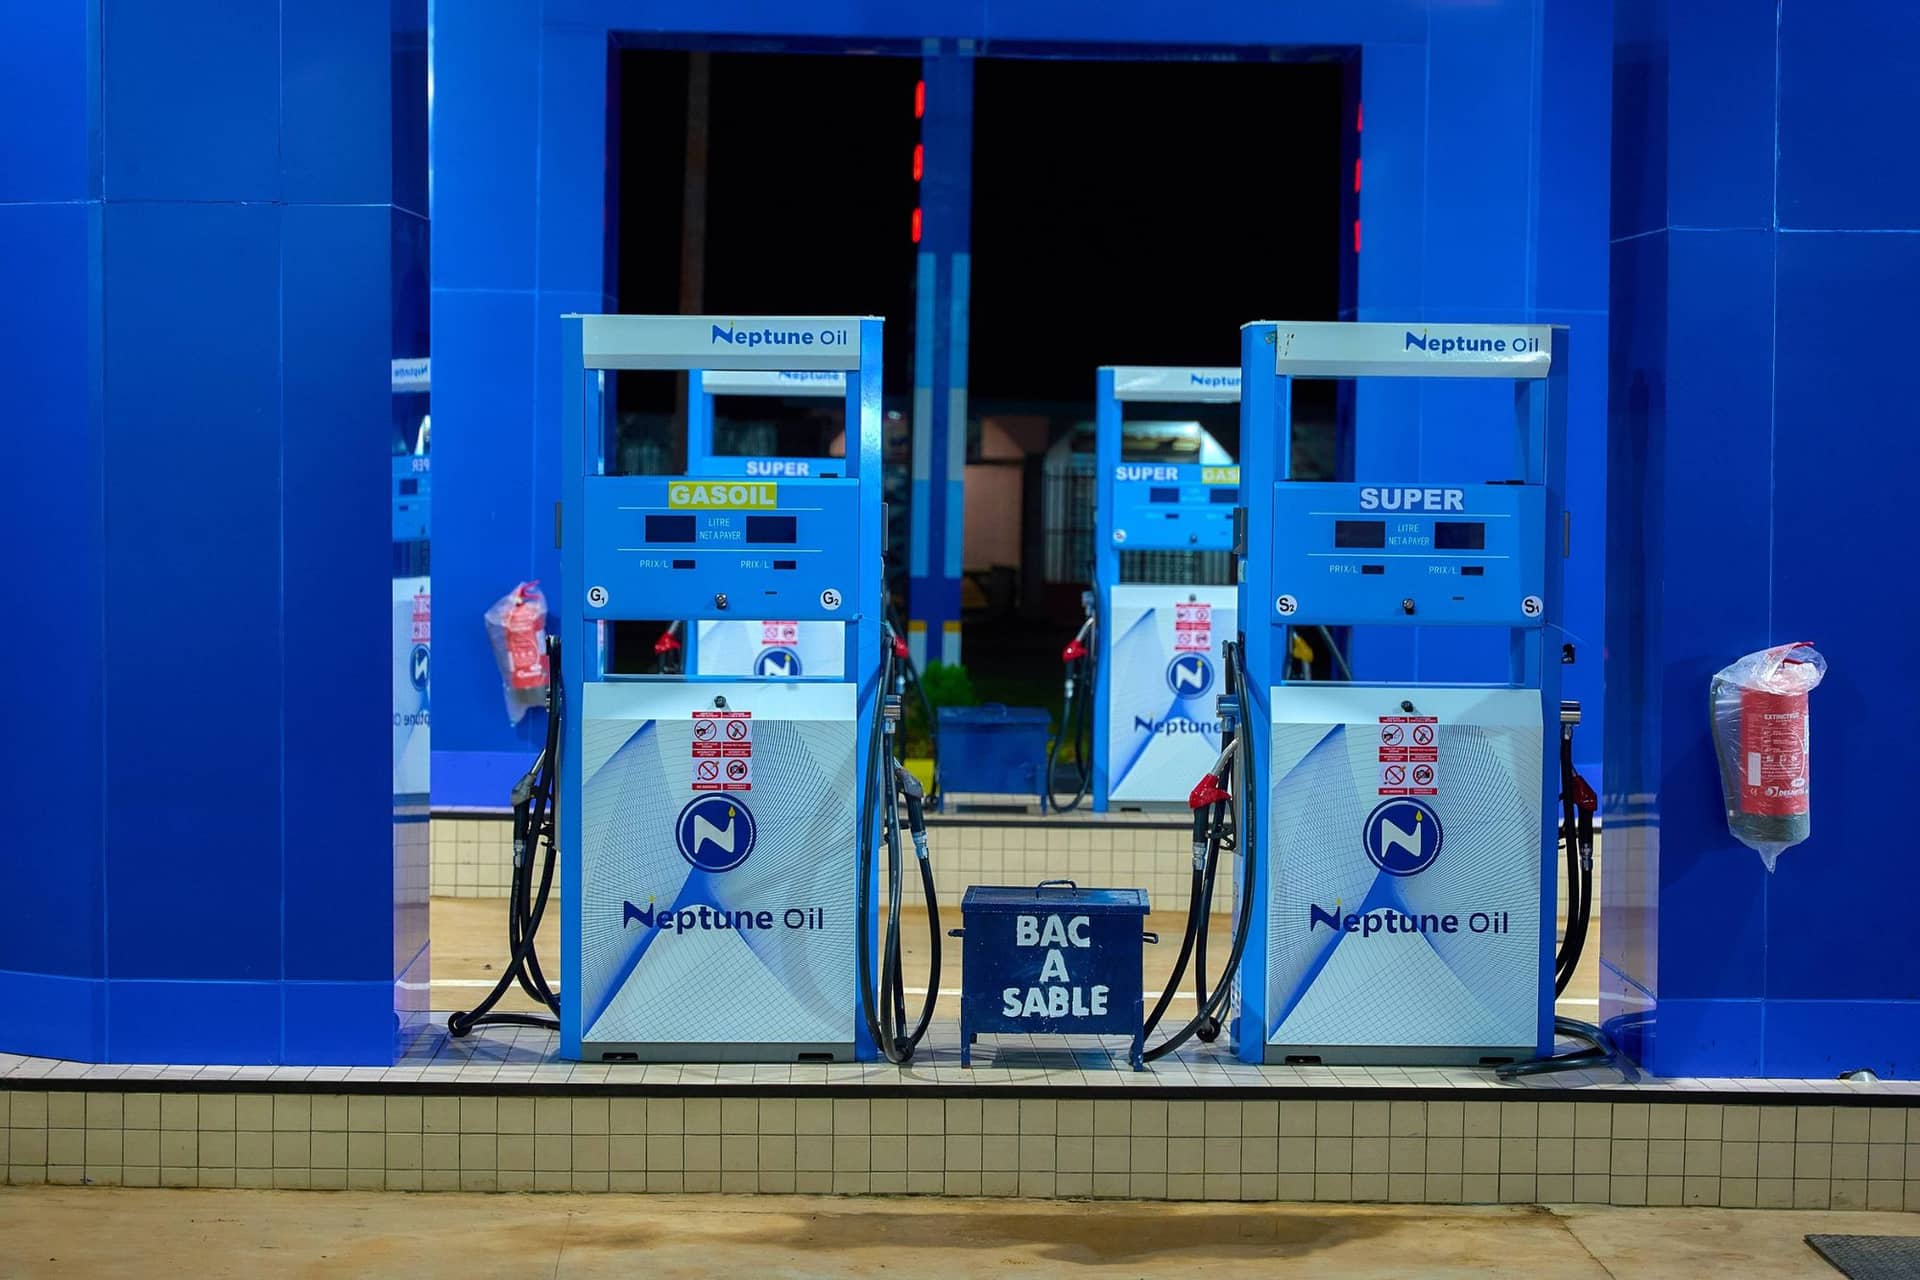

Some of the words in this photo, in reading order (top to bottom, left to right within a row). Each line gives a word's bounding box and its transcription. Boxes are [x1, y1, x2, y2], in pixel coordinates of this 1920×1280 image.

[712, 323, 813, 347] Neptune
[820, 330, 847, 346] Oil
[1405, 330, 1506, 354] Neptune
[1512, 337, 1539, 353] Oil
[746, 460, 809, 476] SUPER
[1115, 466, 1178, 481] SUPER
[1203, 467, 1239, 482] GAS
[670, 485, 775, 505] GASOIL
[1360, 488, 1464, 511] SUPER
[708, 518, 730, 528] LITRE
[1397, 523, 1420, 533] LITRE
[639, 559, 669, 569] PRIX/L
[740, 560, 770, 569] PRIX/L
[1329, 564, 1358, 574] PRIX/L
[1429, 566, 1457, 575] PRIX/L
[1134, 715, 1222, 736] Neptune
[694, 810, 735, 854] N
[1381, 813, 1422, 858] N
[623, 899, 774, 935] Neptune
[783, 907, 824, 930] Oil
[1310, 902, 1459, 938] Neptune
[1468, 911, 1509, 934] Oil
[1016, 913, 1091, 948] BAC
[1039, 949, 1070, 984] A
[1002, 985, 1110, 1018] SABLE
